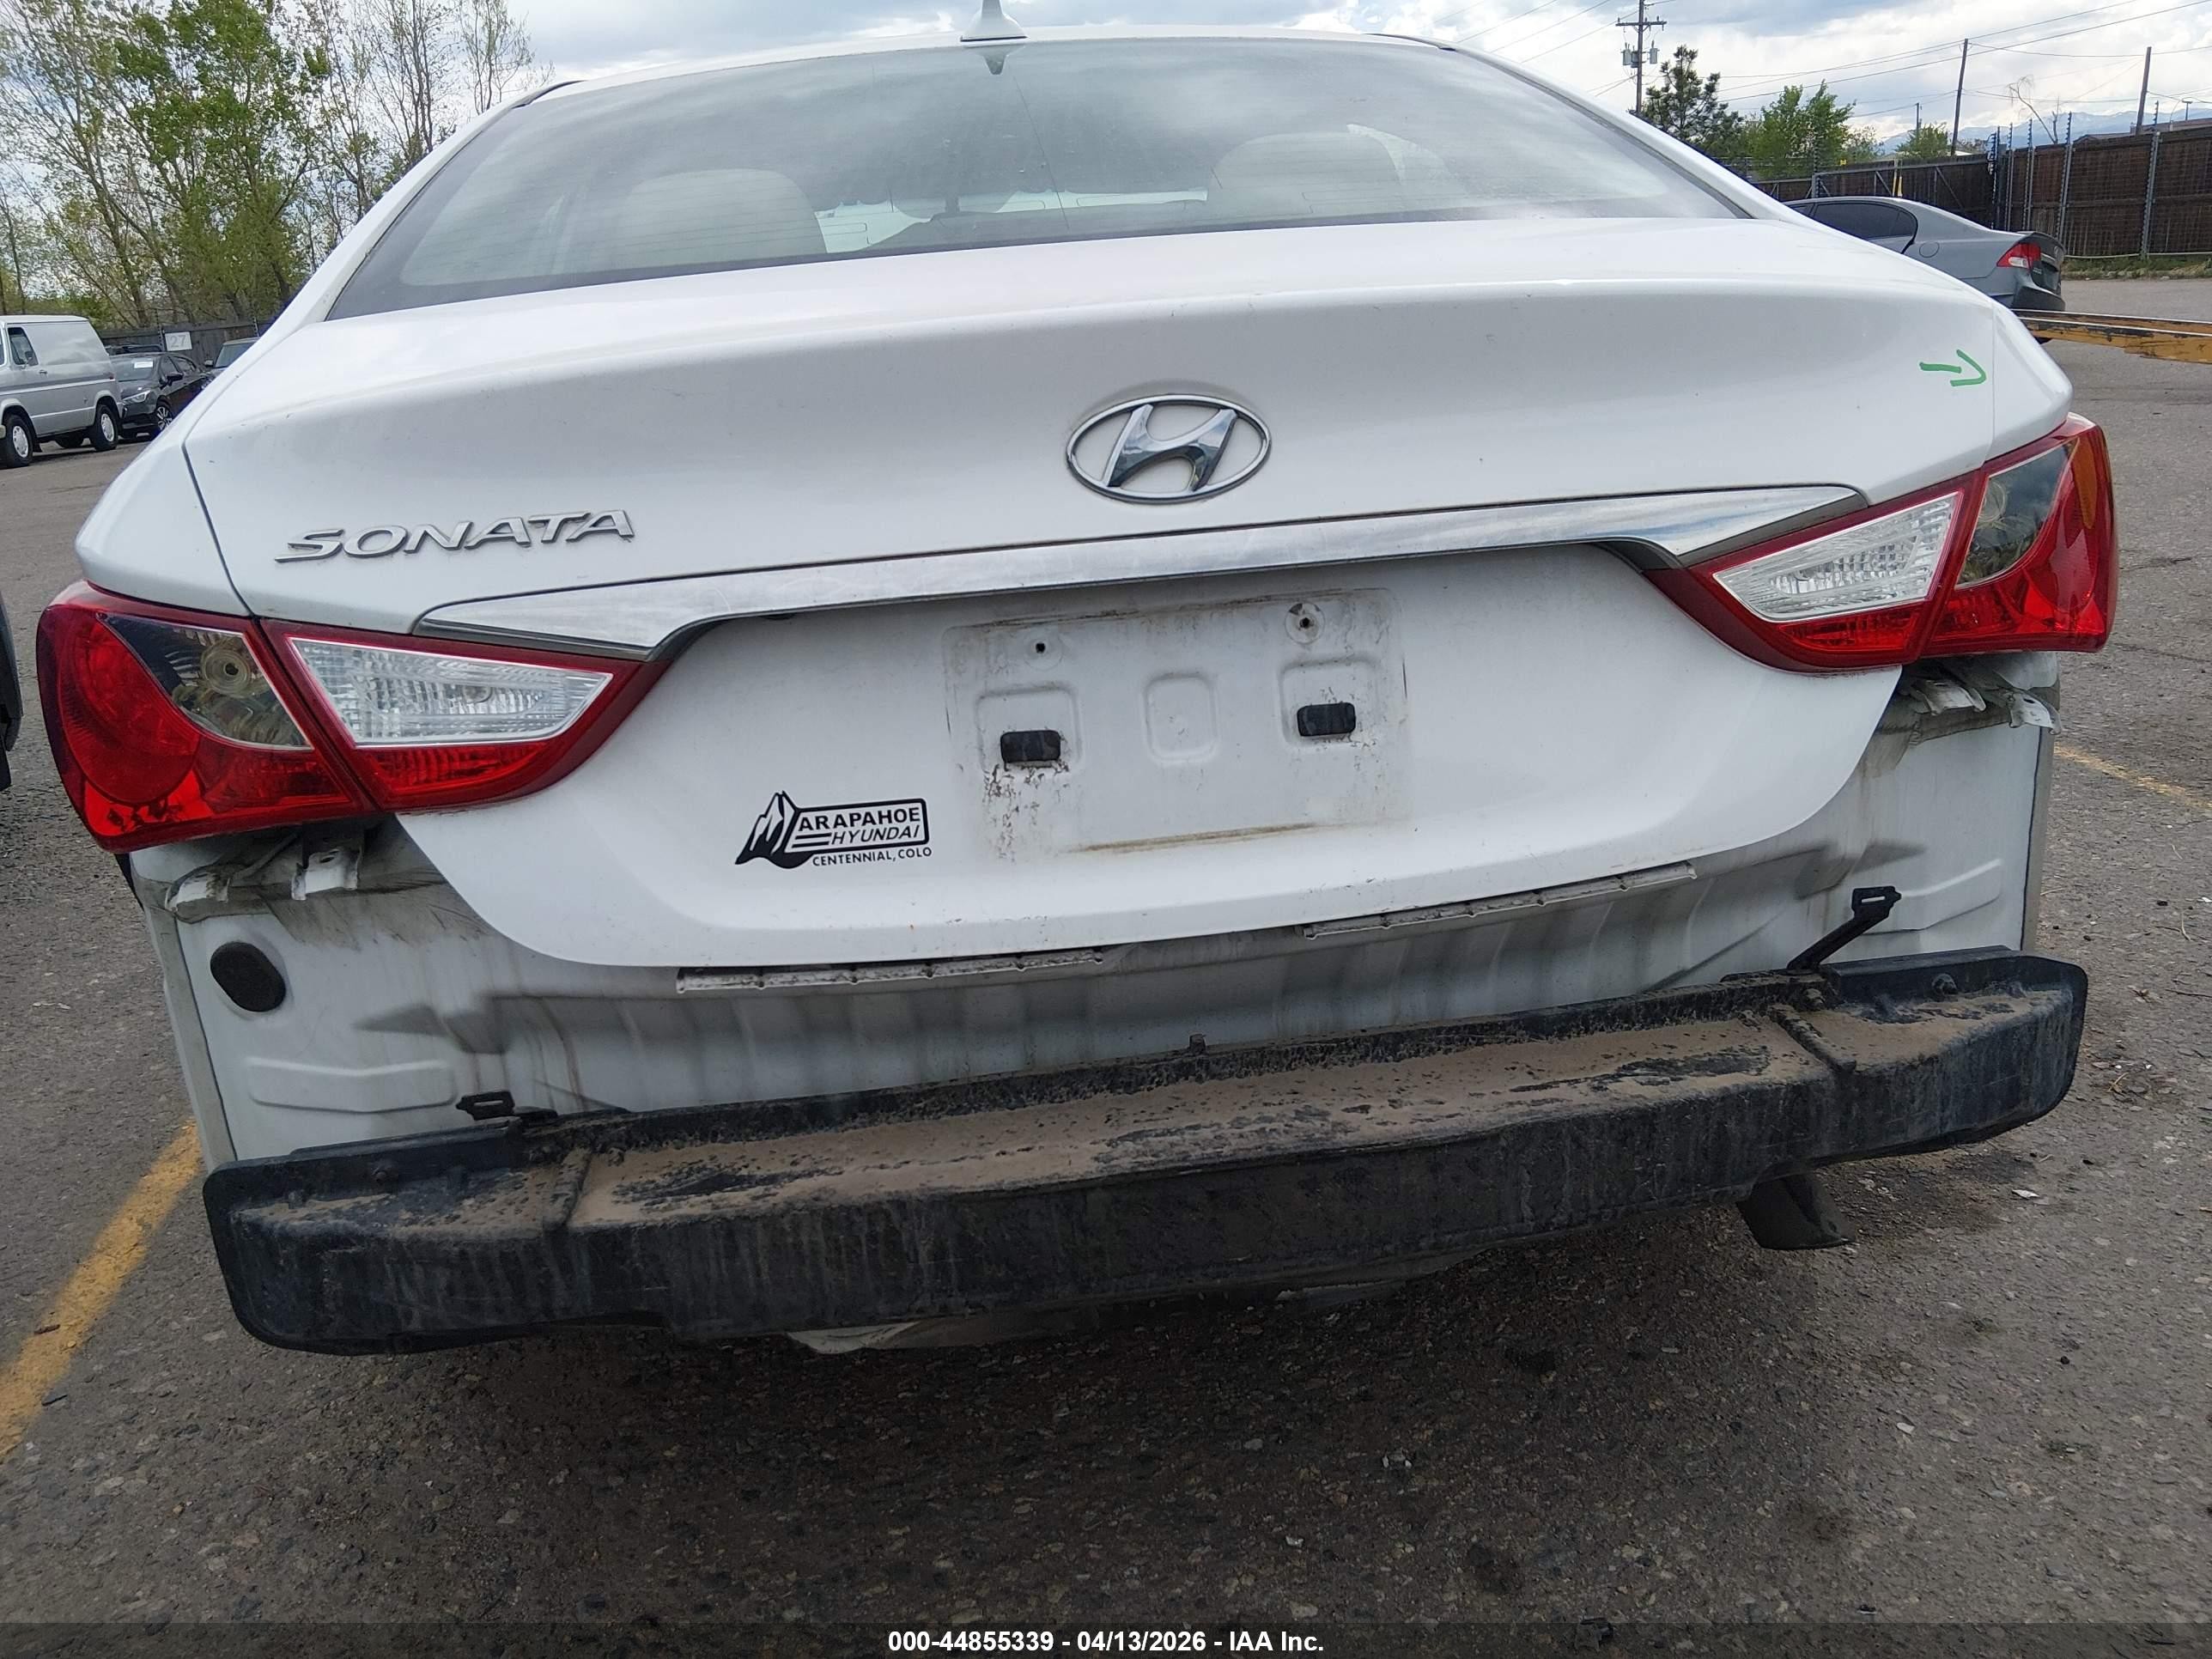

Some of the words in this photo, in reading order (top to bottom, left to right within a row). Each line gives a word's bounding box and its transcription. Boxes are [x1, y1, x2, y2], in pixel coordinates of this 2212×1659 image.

[274, 509, 635, 563] SONATA
[798, 807, 921, 832] ARAPAHOE
[831, 824, 921, 845] HYUNDAI
[812, 850, 896, 866] CENTENNIAL,
[897, 847, 933, 860] COLO
